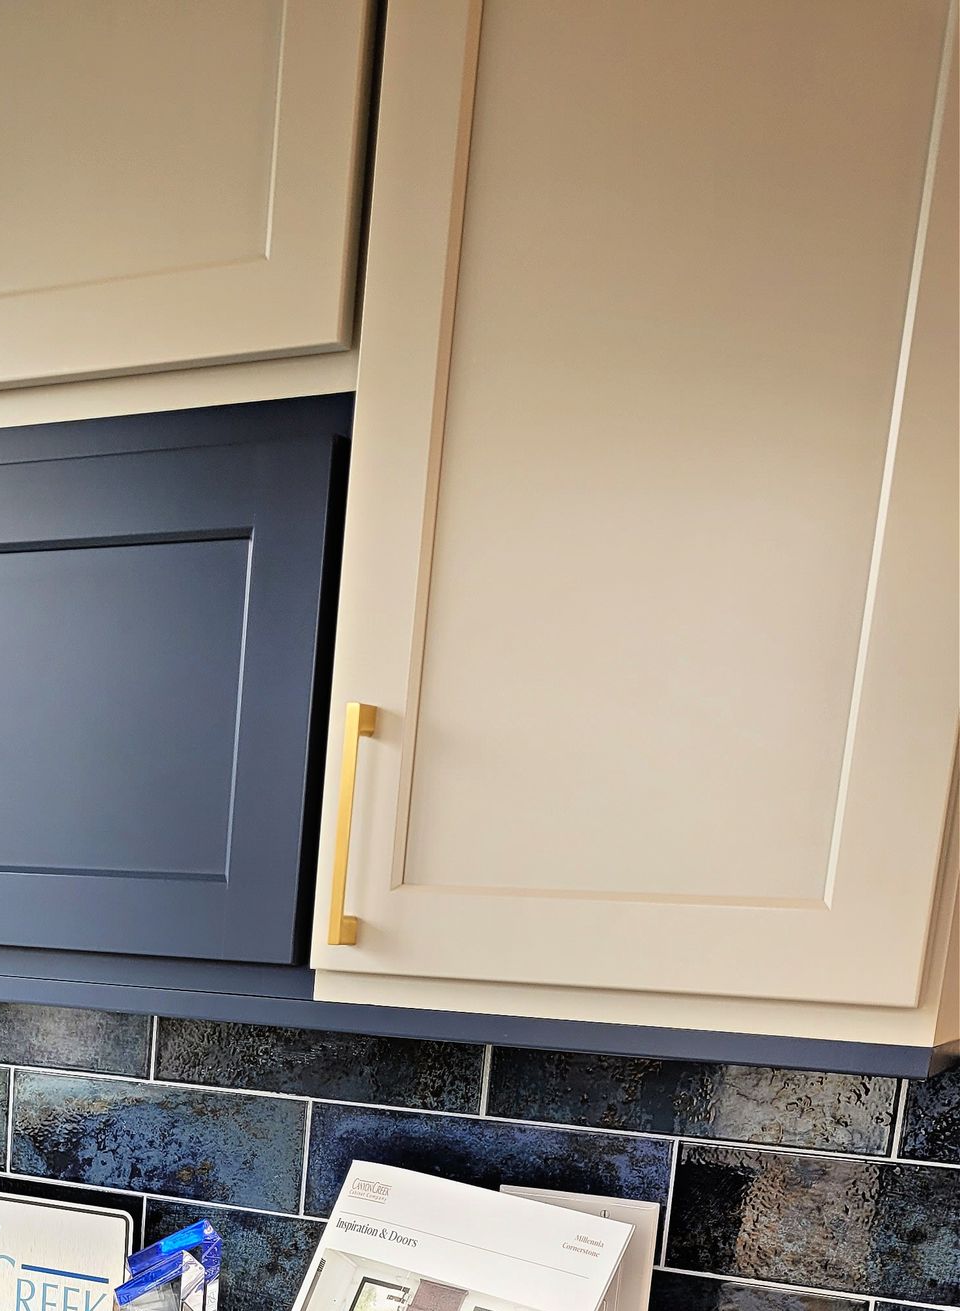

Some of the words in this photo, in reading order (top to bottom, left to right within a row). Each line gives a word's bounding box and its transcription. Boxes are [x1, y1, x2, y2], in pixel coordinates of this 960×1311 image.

[336, 1217, 378, 1237] Inspiration
[379, 1228, 388, 1240] &
[388, 1230, 419, 1248] Doors
[575, 1234, 605, 1248] Millennia
[561, 1241, 600, 1258] Cornerstone
